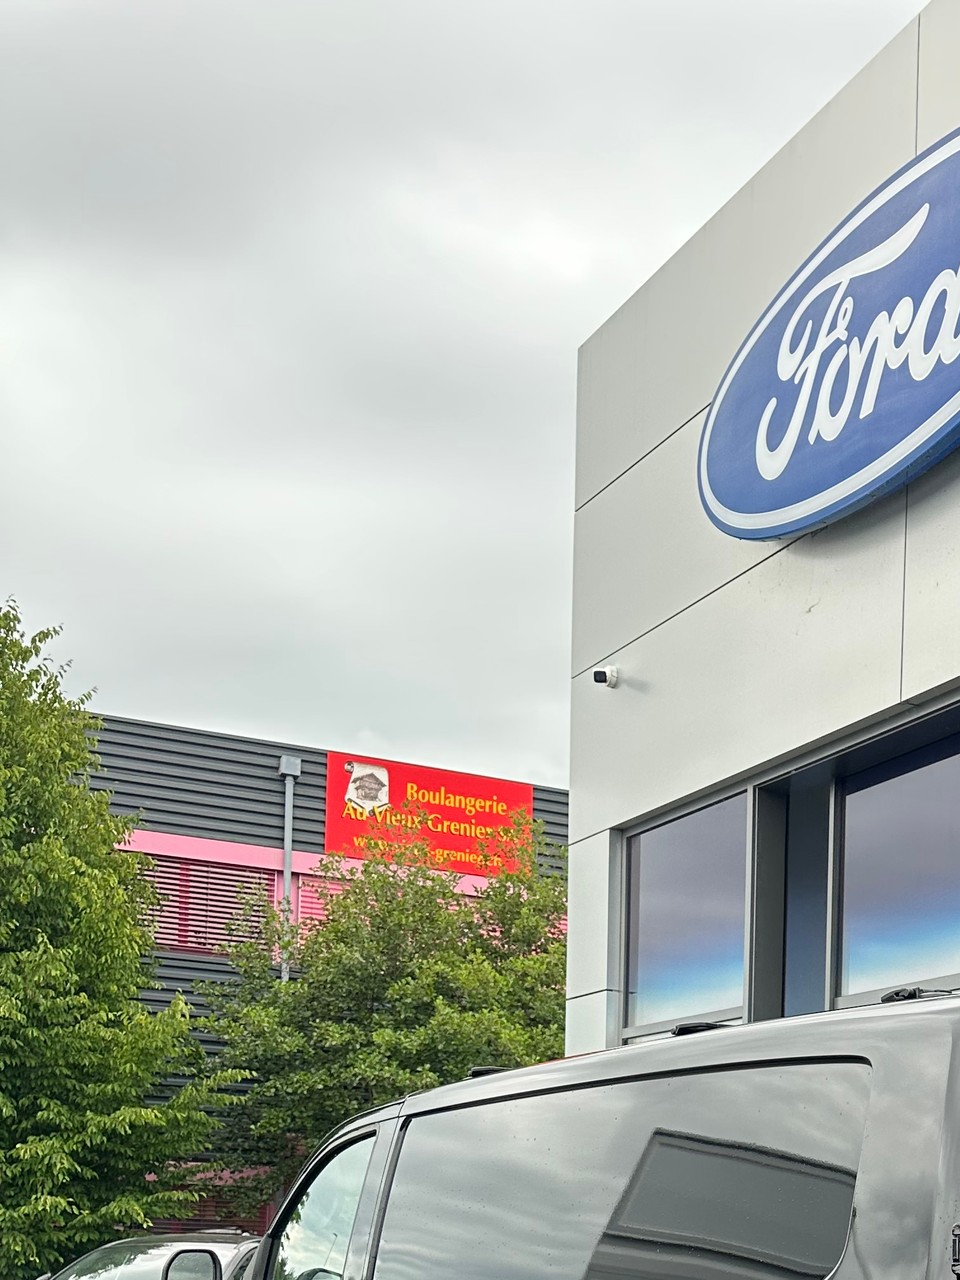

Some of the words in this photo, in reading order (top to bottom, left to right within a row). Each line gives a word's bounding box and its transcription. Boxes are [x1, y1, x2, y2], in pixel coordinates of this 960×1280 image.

[406, 782, 508, 816] Boulangerie
[341, 800, 368, 821] Au
[374, 805, 421, 829] Vieux
[427, 813, 494, 840] Grenier
